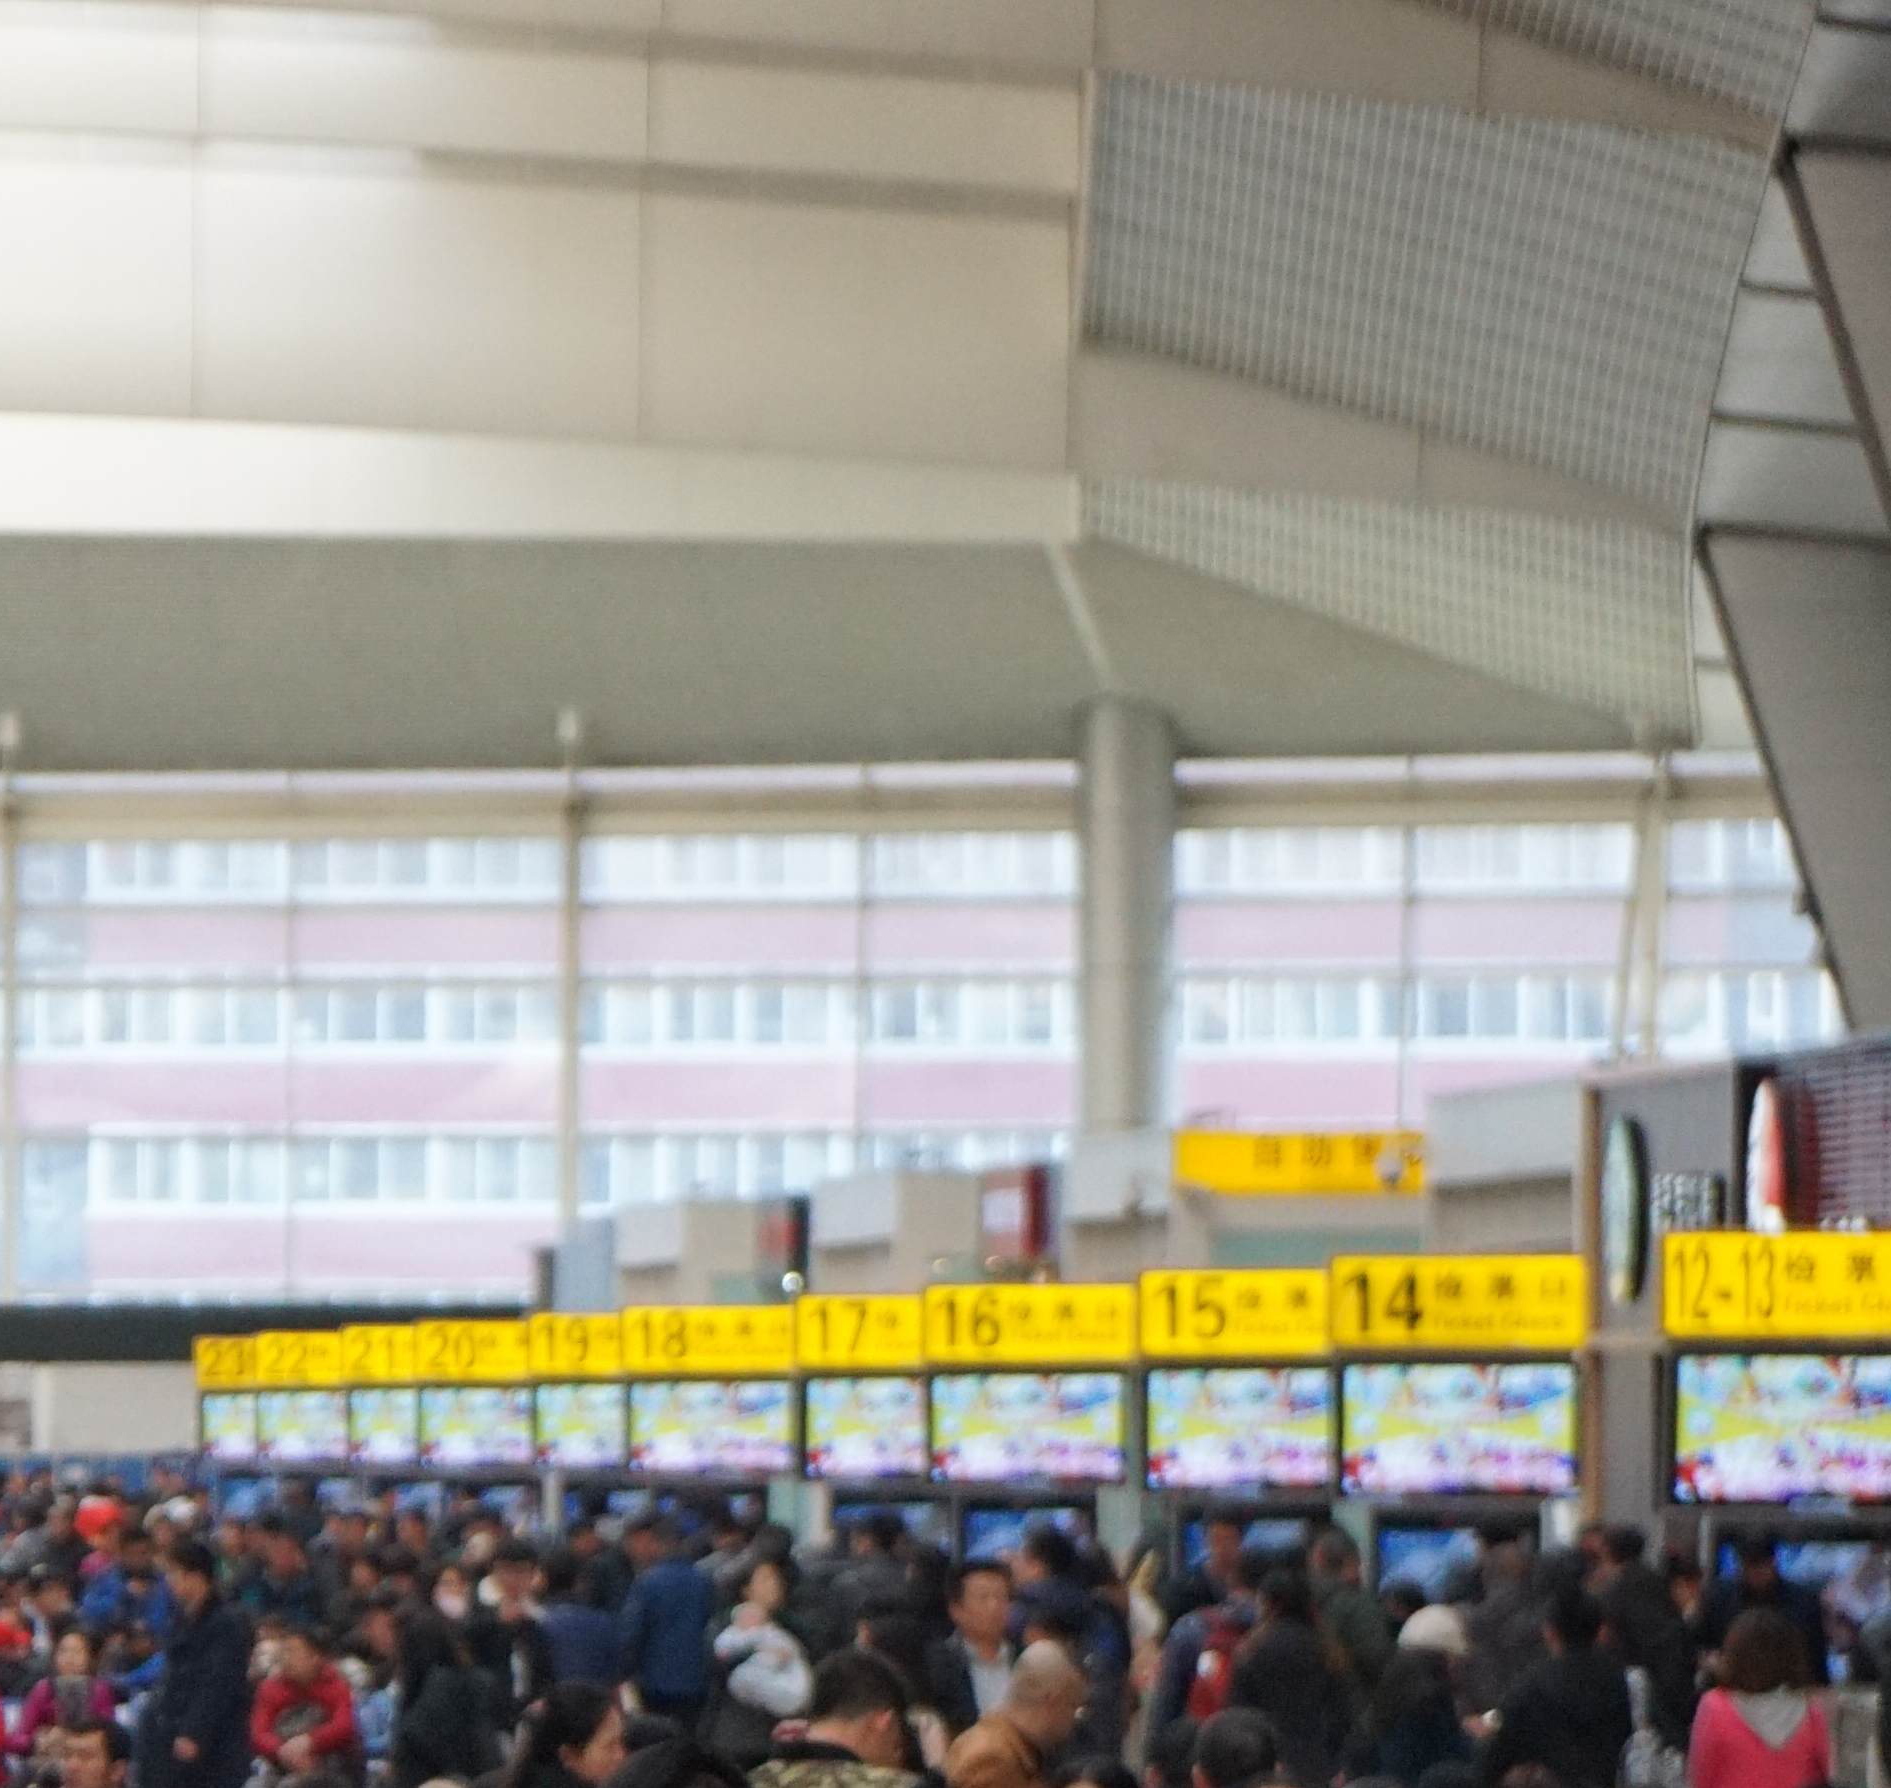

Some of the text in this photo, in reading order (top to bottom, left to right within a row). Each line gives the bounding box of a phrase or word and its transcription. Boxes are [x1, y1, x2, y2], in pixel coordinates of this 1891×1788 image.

[810, 1300, 868, 1354] 17
[938, 1289, 999, 1347] 16
[1156, 1275, 1226, 1339] 15
[1345, 1267, 1422, 1332] 14
[535, 1316, 588, 1362] 19
[630, 1311, 687, 1358] 18
